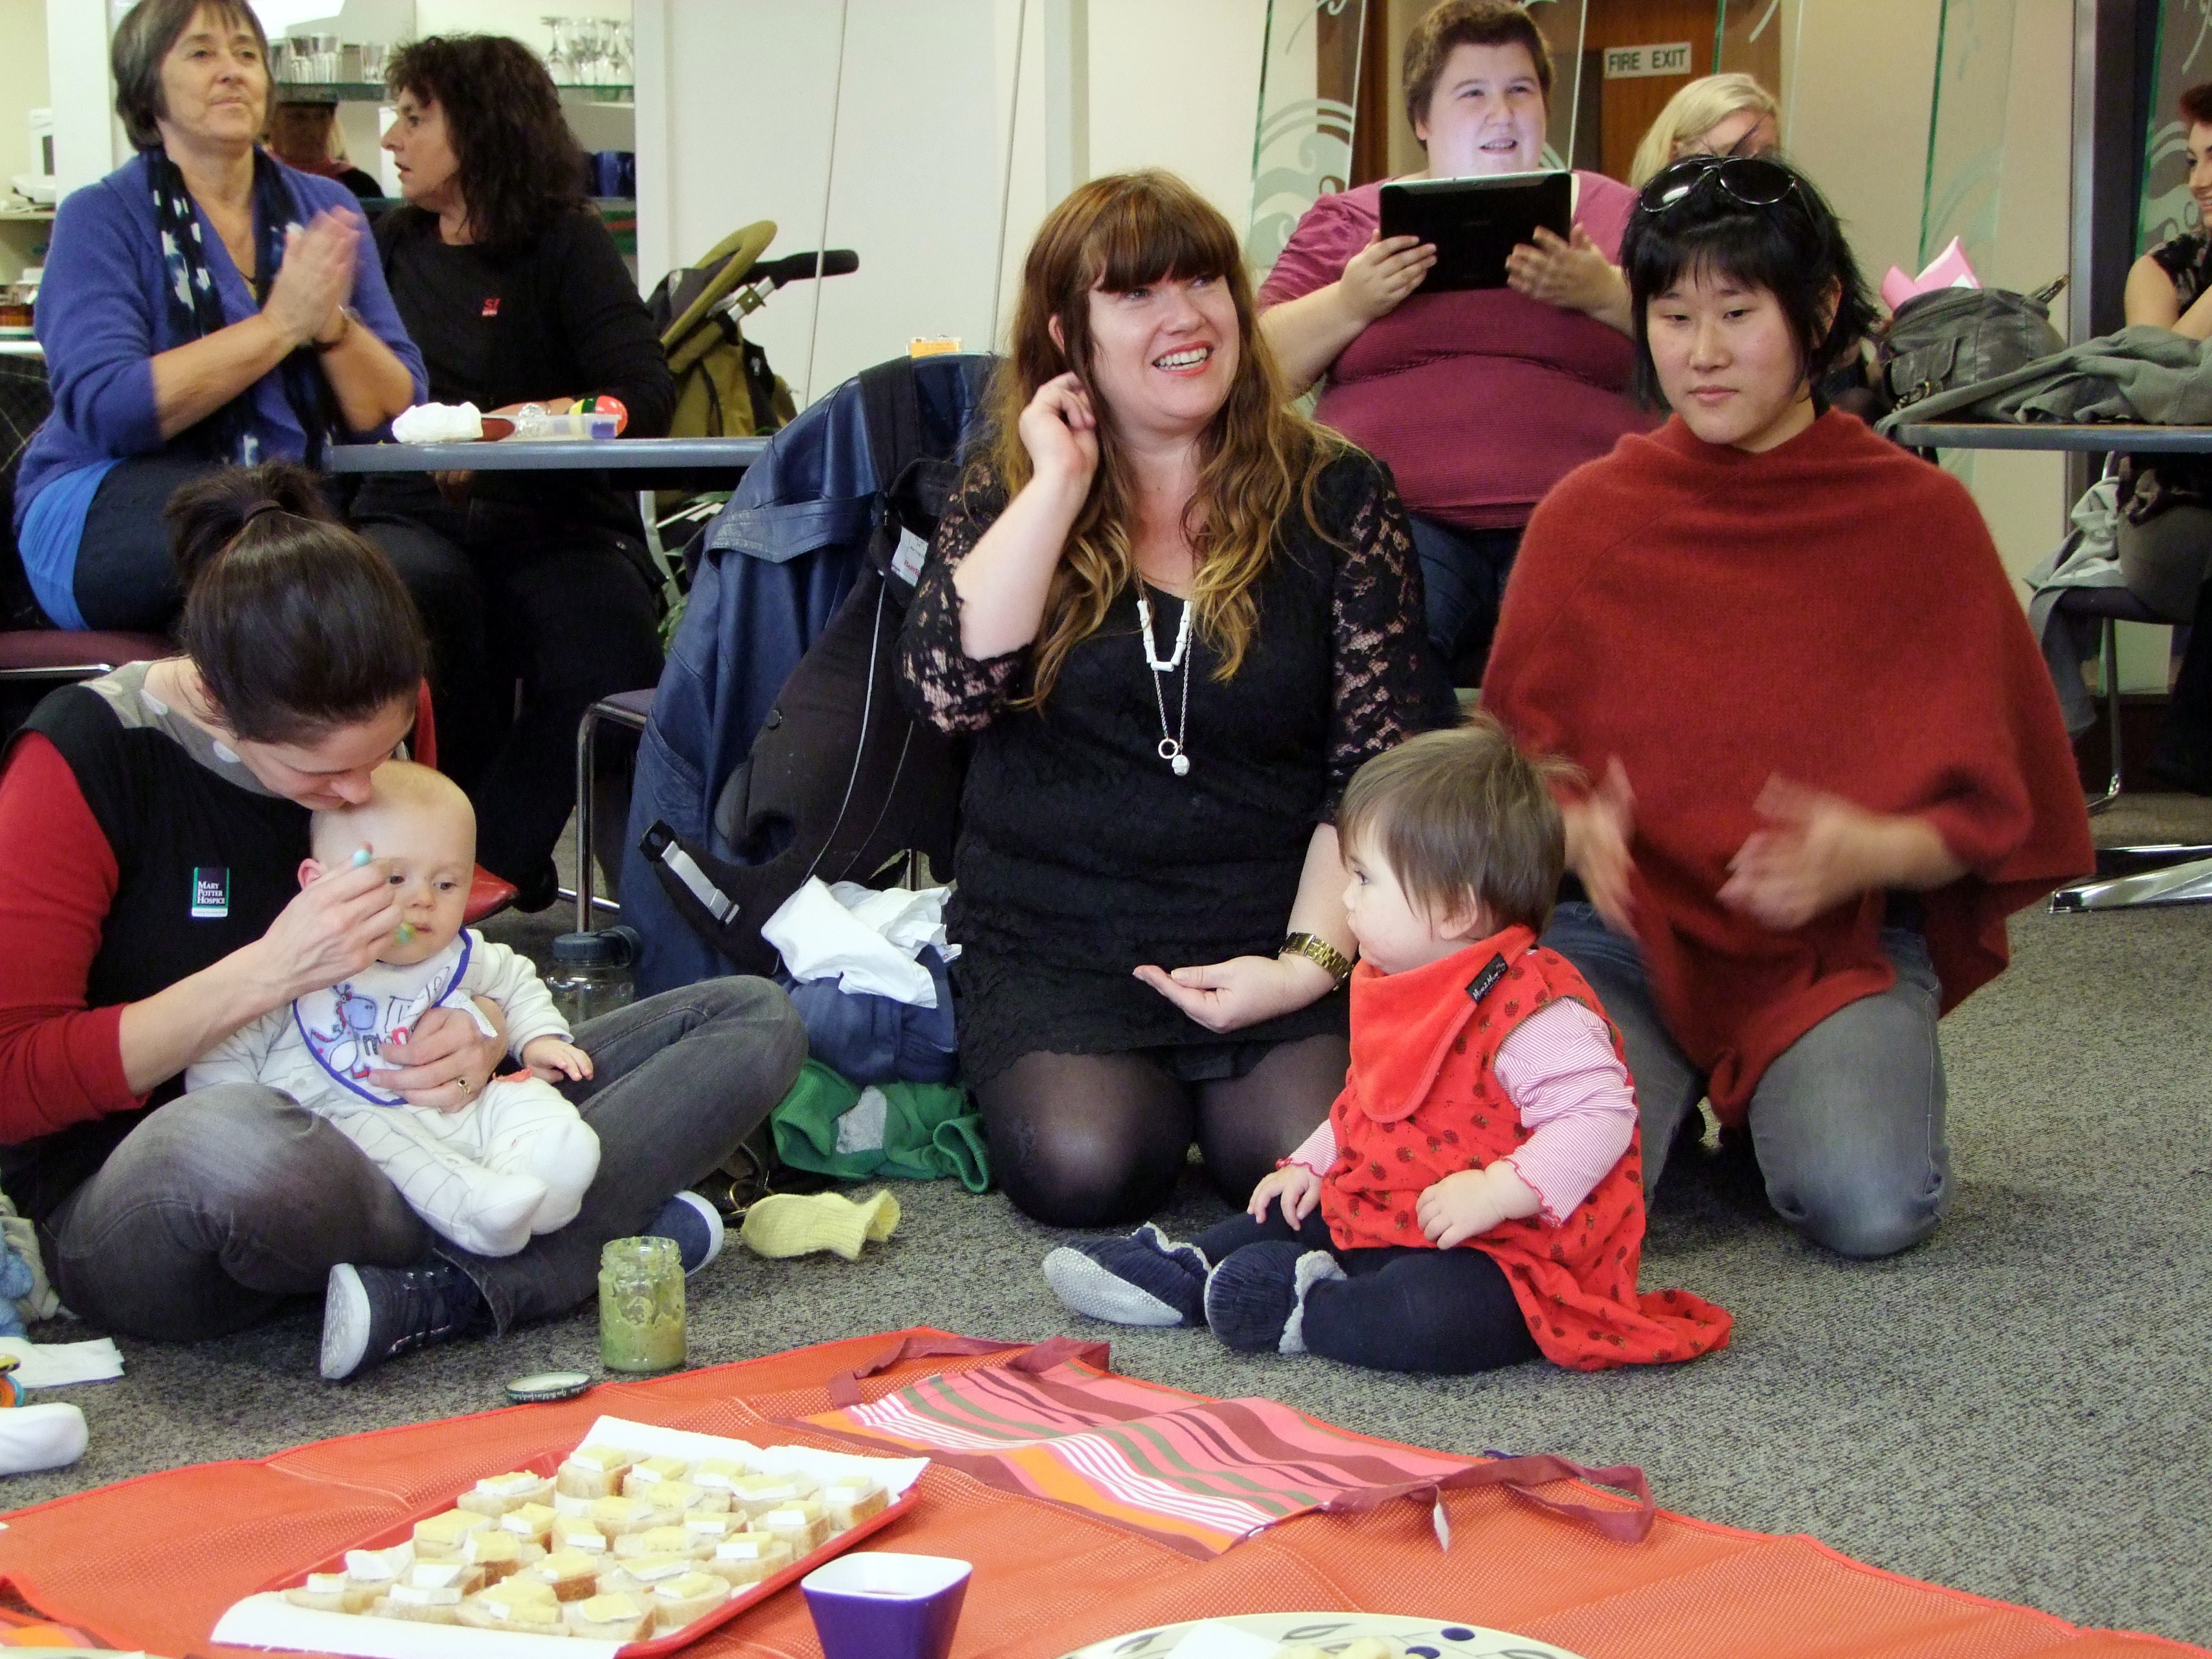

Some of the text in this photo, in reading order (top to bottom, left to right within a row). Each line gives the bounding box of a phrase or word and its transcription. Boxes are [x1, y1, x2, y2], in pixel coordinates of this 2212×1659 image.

[1608, 47, 1686, 71] FIRE EXIT
[197, 896, 225, 904] HOSPICE
